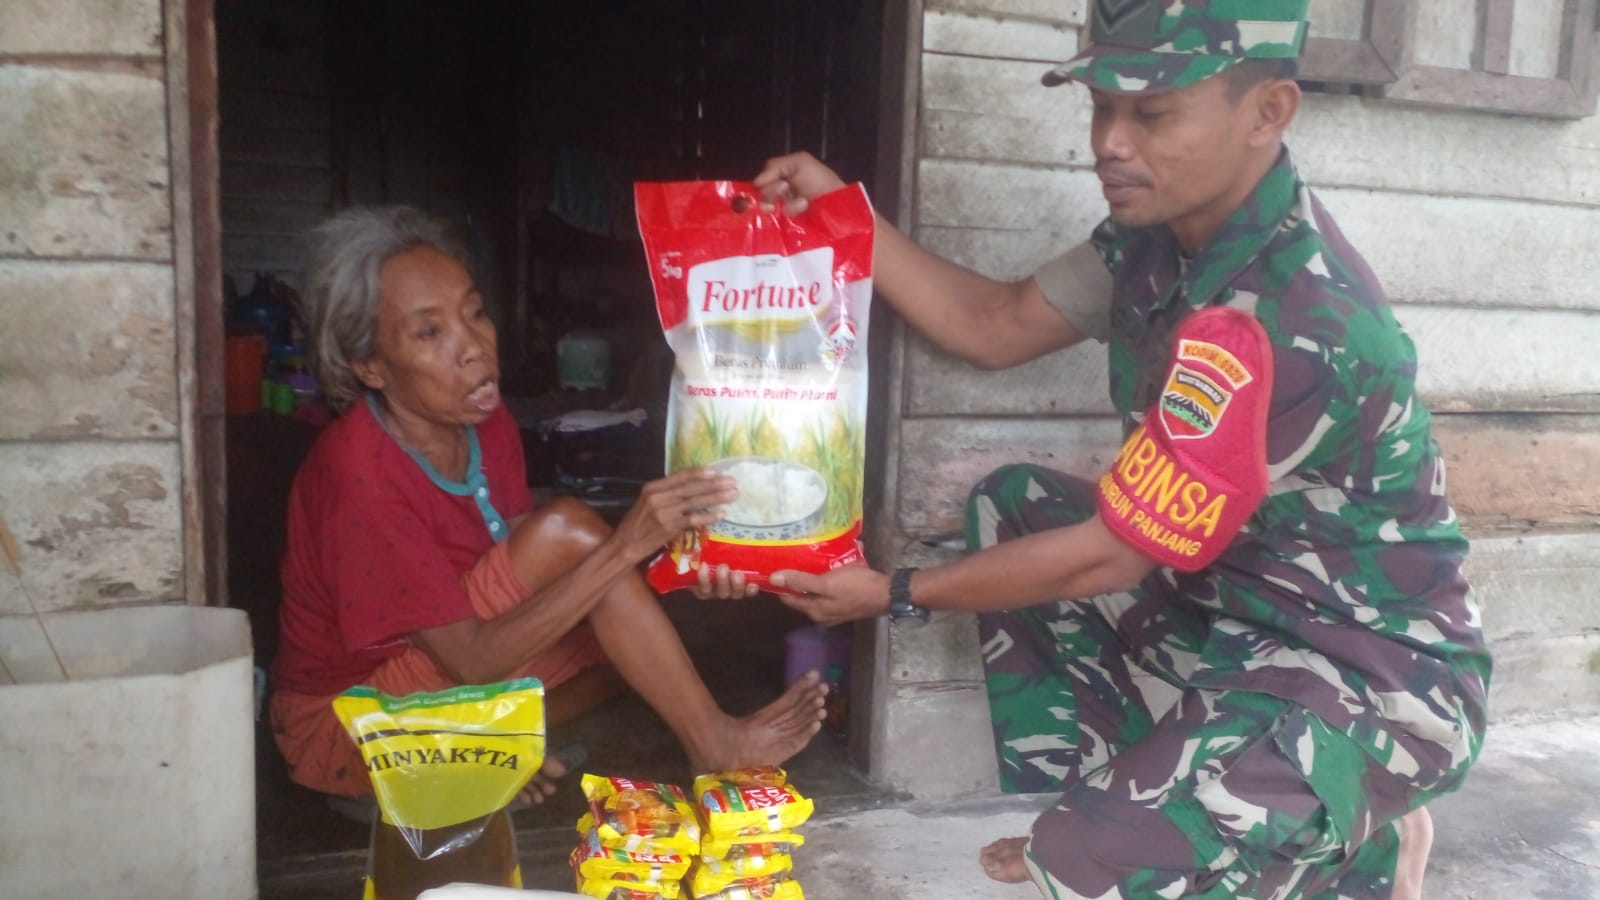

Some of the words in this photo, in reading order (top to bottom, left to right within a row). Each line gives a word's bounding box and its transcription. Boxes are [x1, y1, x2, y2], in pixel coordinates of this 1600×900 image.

[702, 280, 821, 312] Fortune
[686, 384, 717, 397] Beras
[1128, 509, 1203, 556] PANJANG
[367, 747, 519, 772] MINYAKITA
